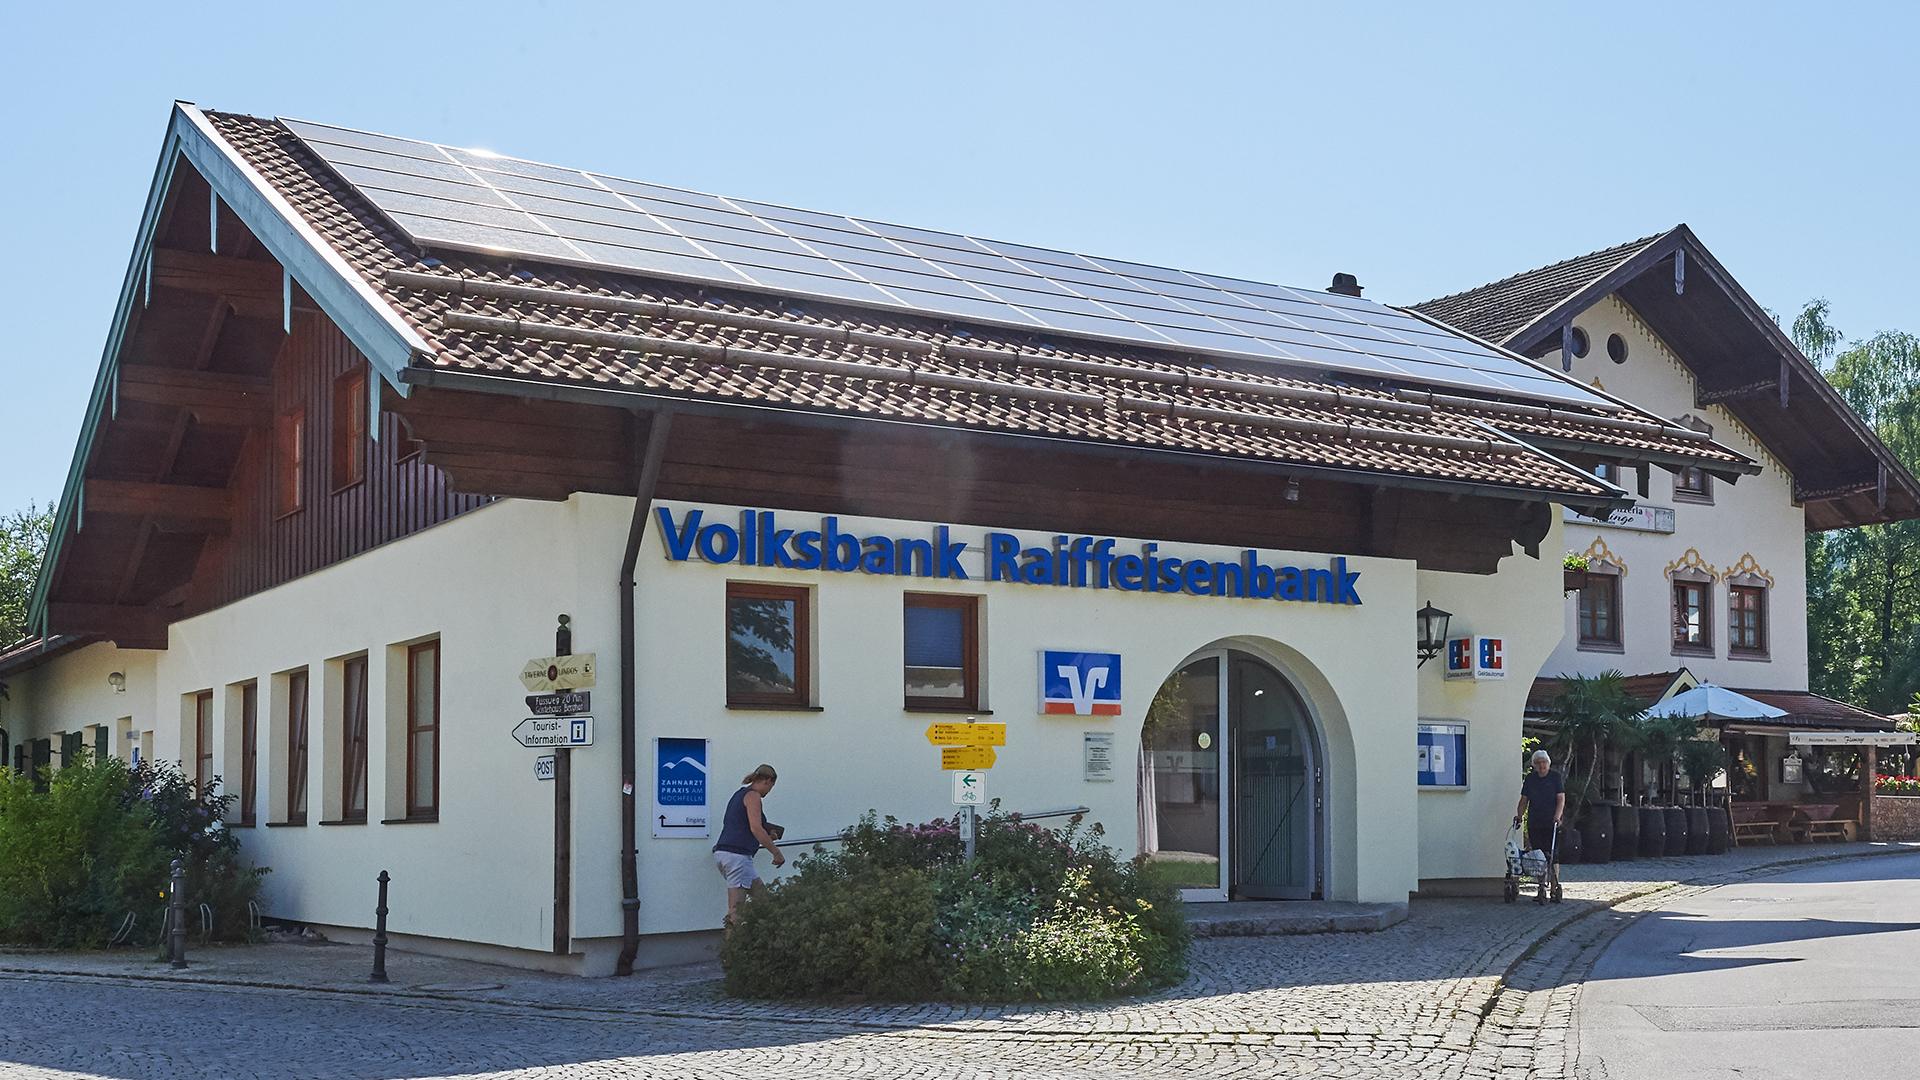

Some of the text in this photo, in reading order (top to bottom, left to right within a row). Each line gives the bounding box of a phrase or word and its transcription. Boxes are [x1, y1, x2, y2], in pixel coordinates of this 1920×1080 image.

[653, 506, 1363, 605] Volksbank Raiffeisenbank
[524, 669, 547, 680] TAVERNE
[532, 721, 561, 731] Tourist-
[525, 734, 568, 745] Information
[537, 761, 554, 775] POST
[685, 816, 706, 825] Eingang
